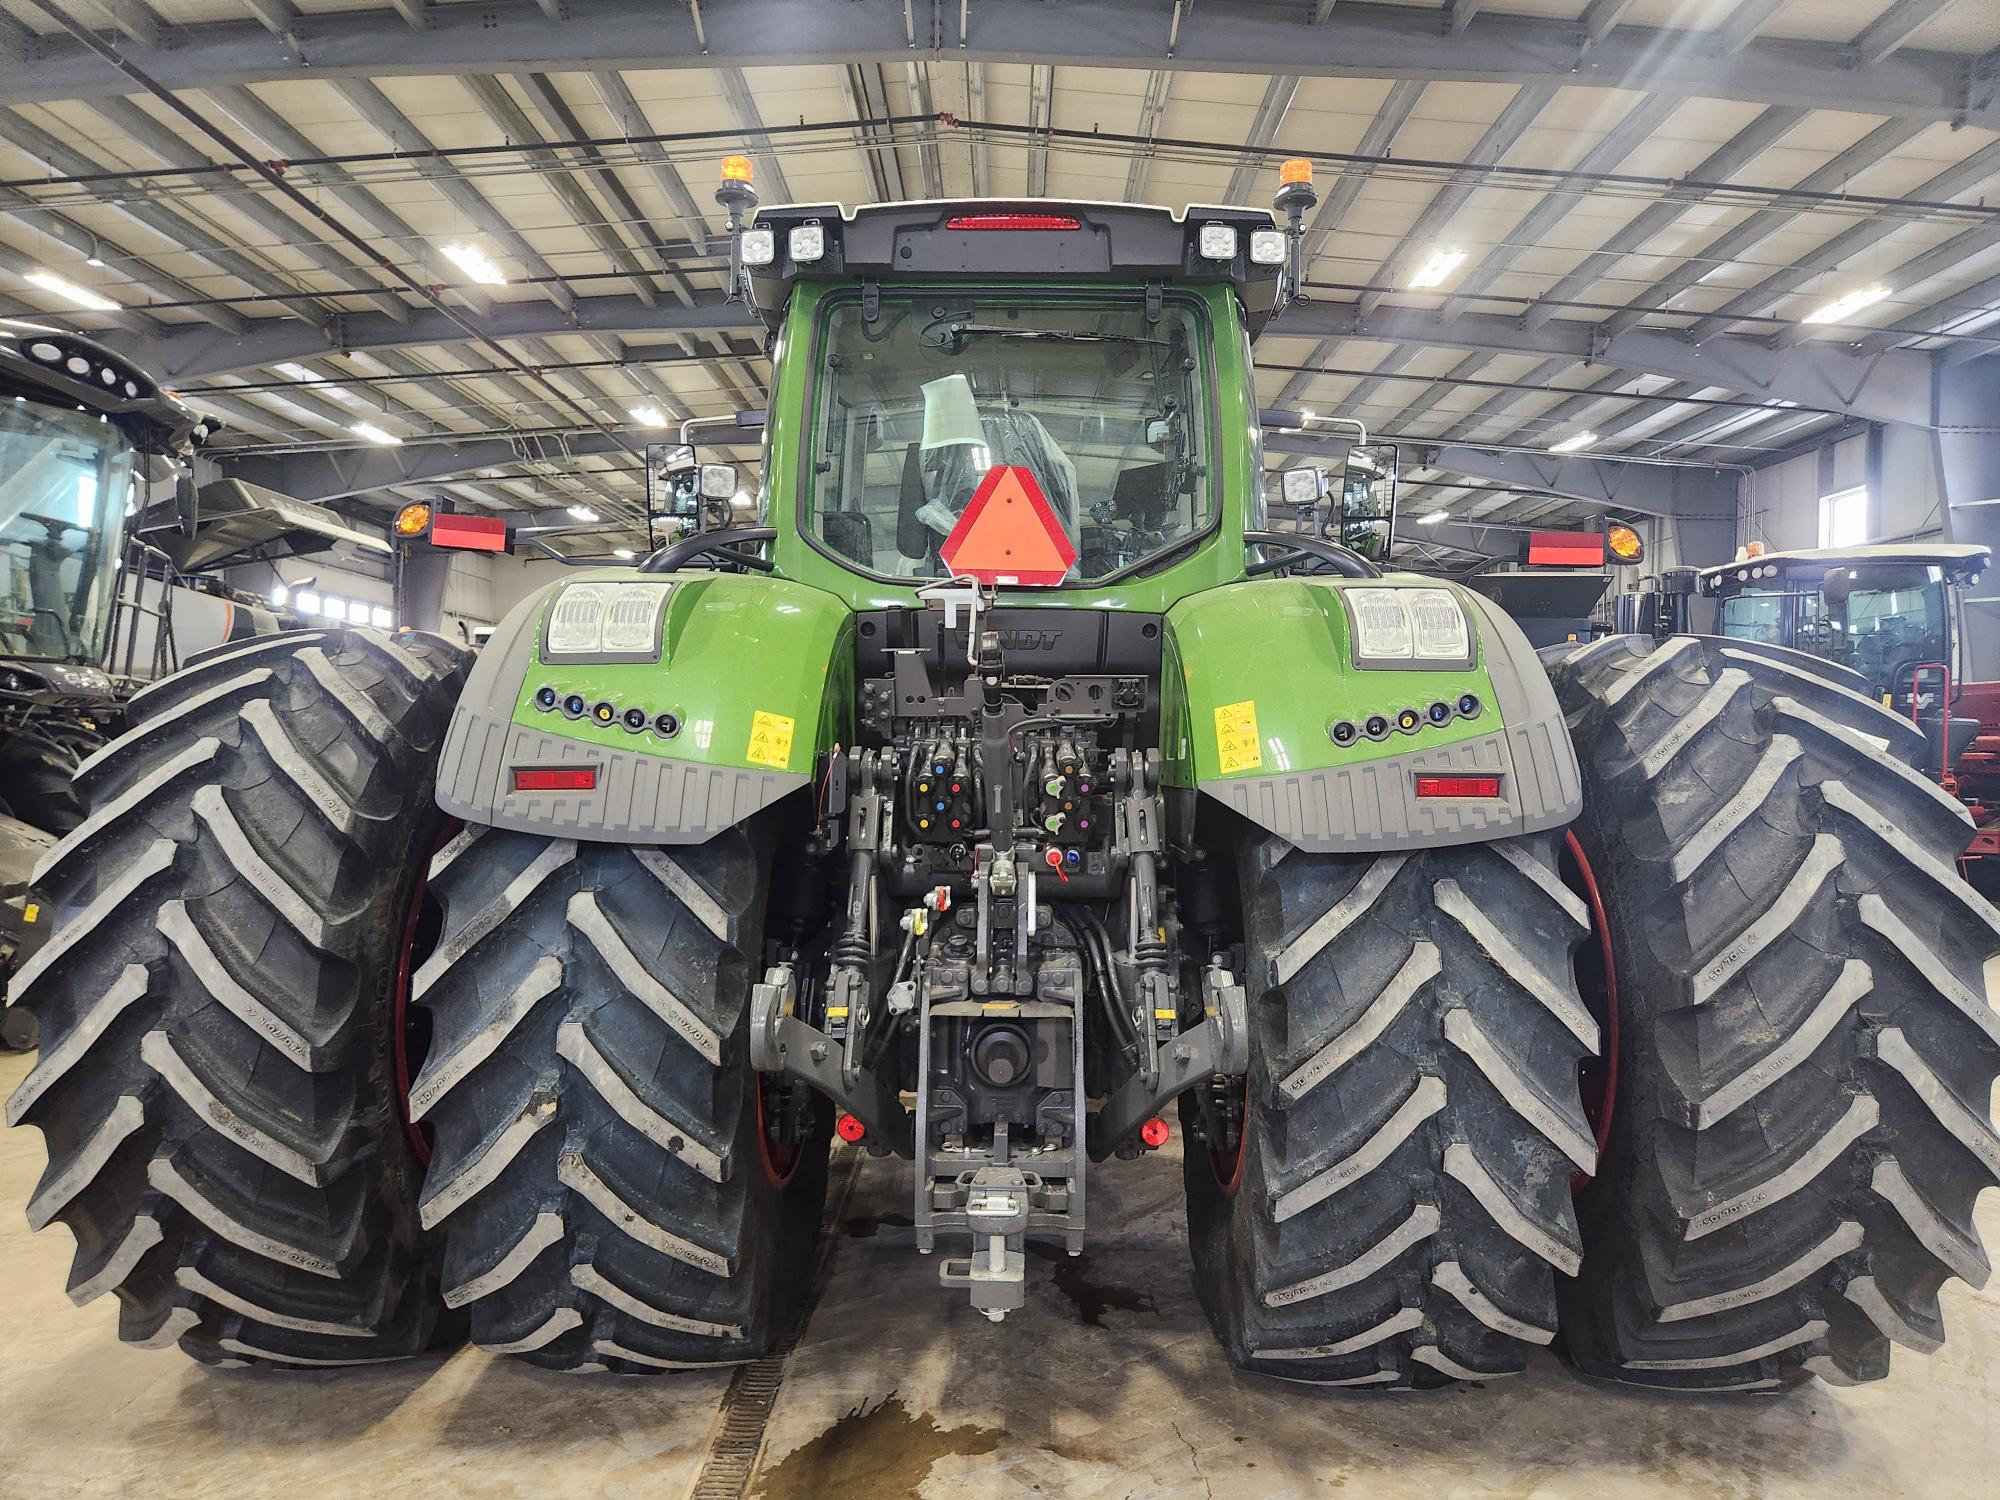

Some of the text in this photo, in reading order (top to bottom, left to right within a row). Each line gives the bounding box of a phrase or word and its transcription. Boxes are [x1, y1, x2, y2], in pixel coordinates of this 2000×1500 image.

[954, 630, 1063, 650] FNDT
[265, 1021, 303, 1057] 750/70
[677, 1016, 712, 1049] 750/70
[1696, 1205, 1738, 1227] 750/70
